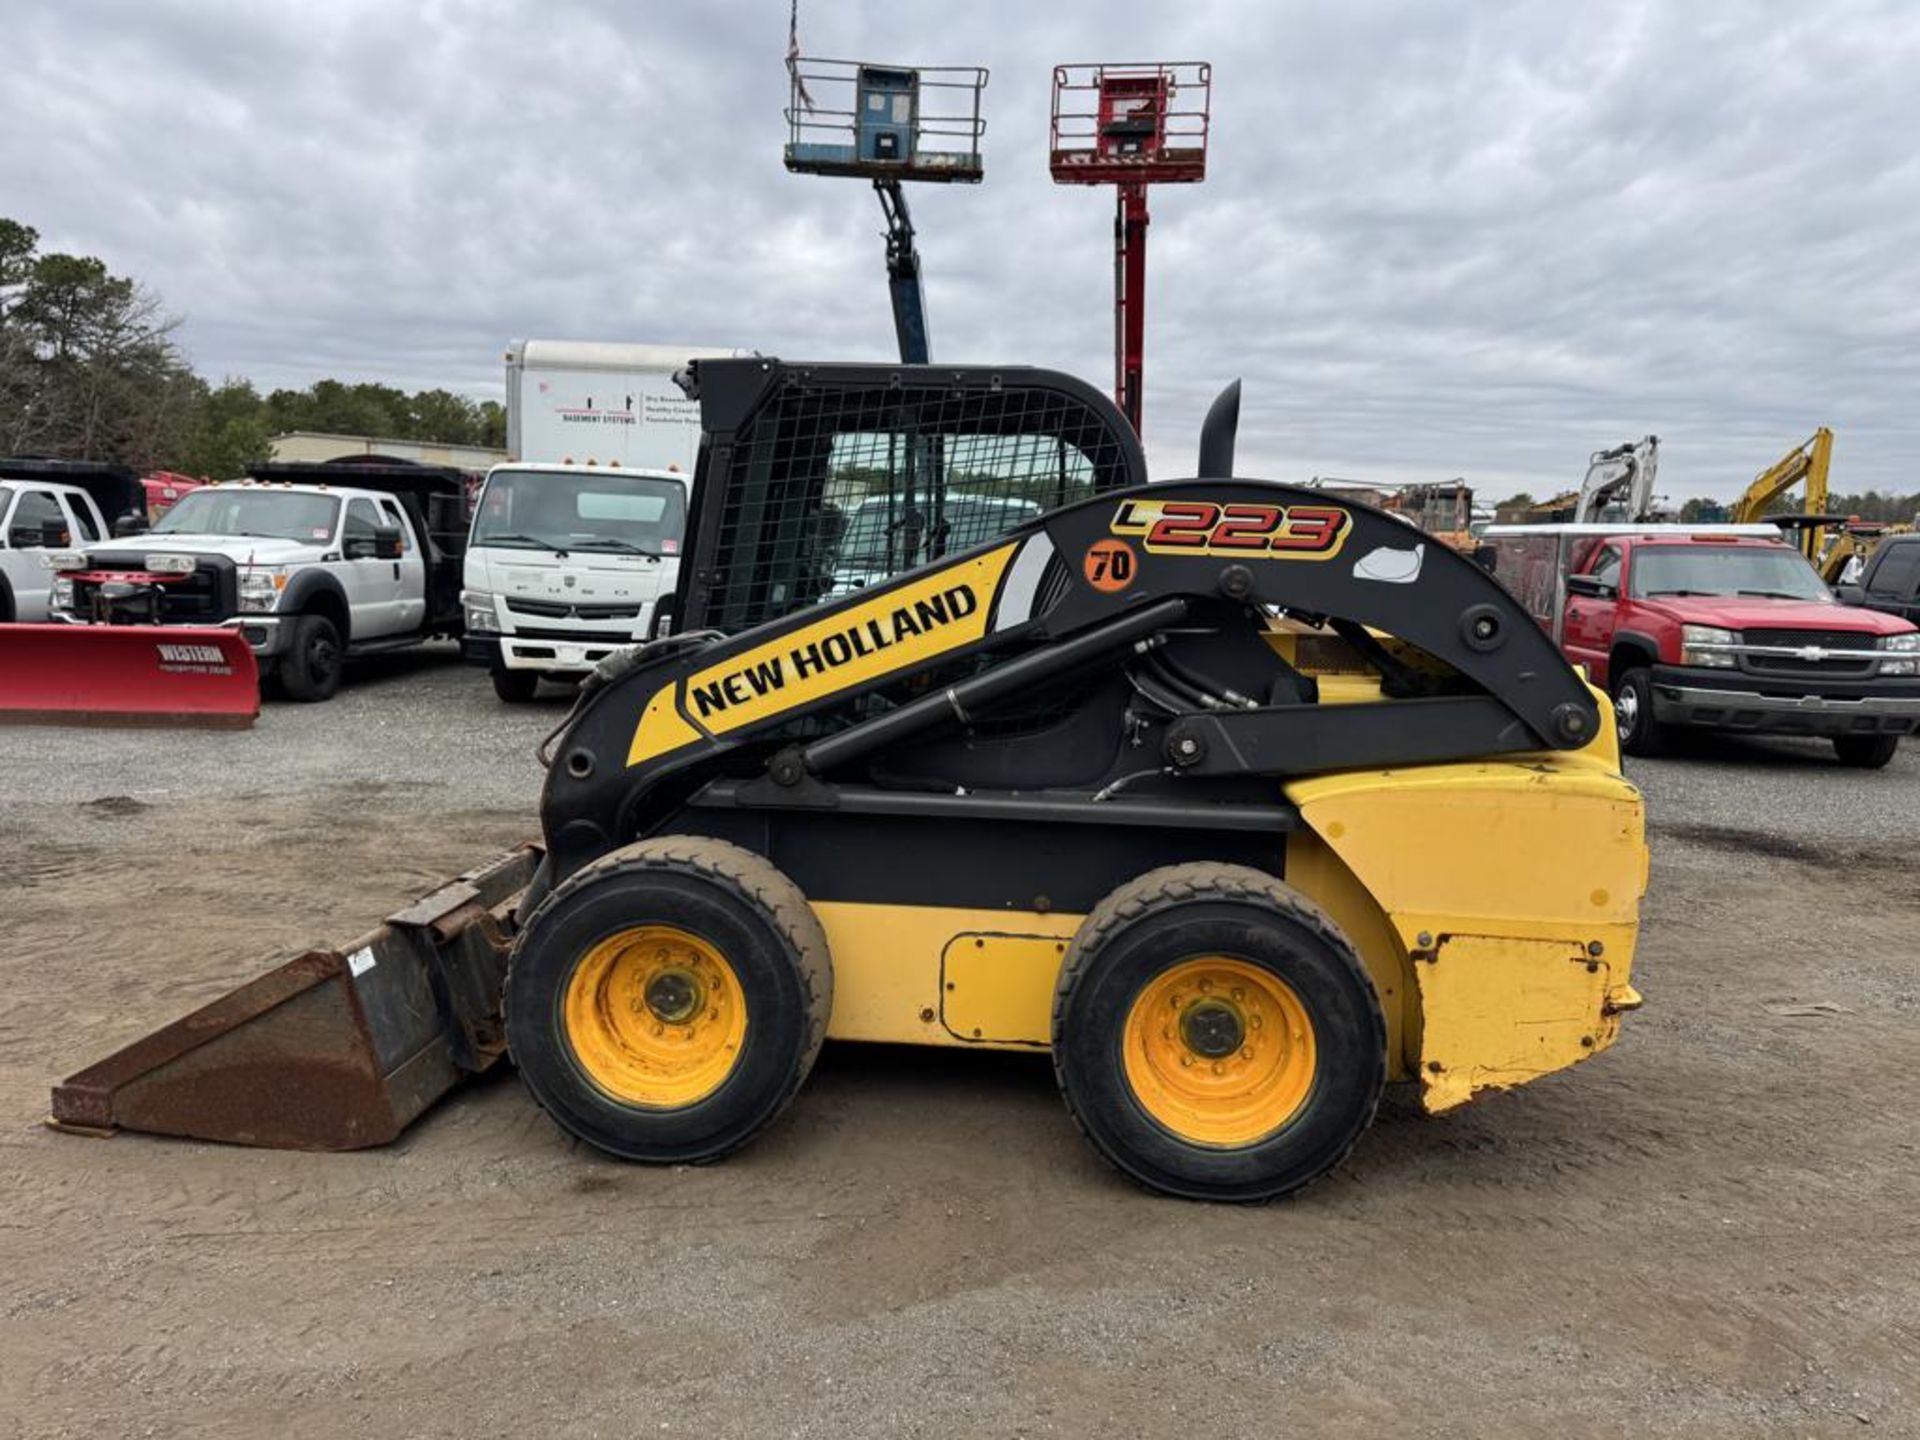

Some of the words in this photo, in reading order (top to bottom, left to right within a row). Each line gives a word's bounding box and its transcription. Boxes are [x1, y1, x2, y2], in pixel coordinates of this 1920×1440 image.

[562, 414, 600, 423] BASEMENT
[603, 415, 636, 425] SYSTEMS
[1091, 550, 1130, 581] 70
[156, 644, 225, 663] WESTERN
[691, 656, 785, 717] NEW
[790, 583, 978, 680] HOLLAND
